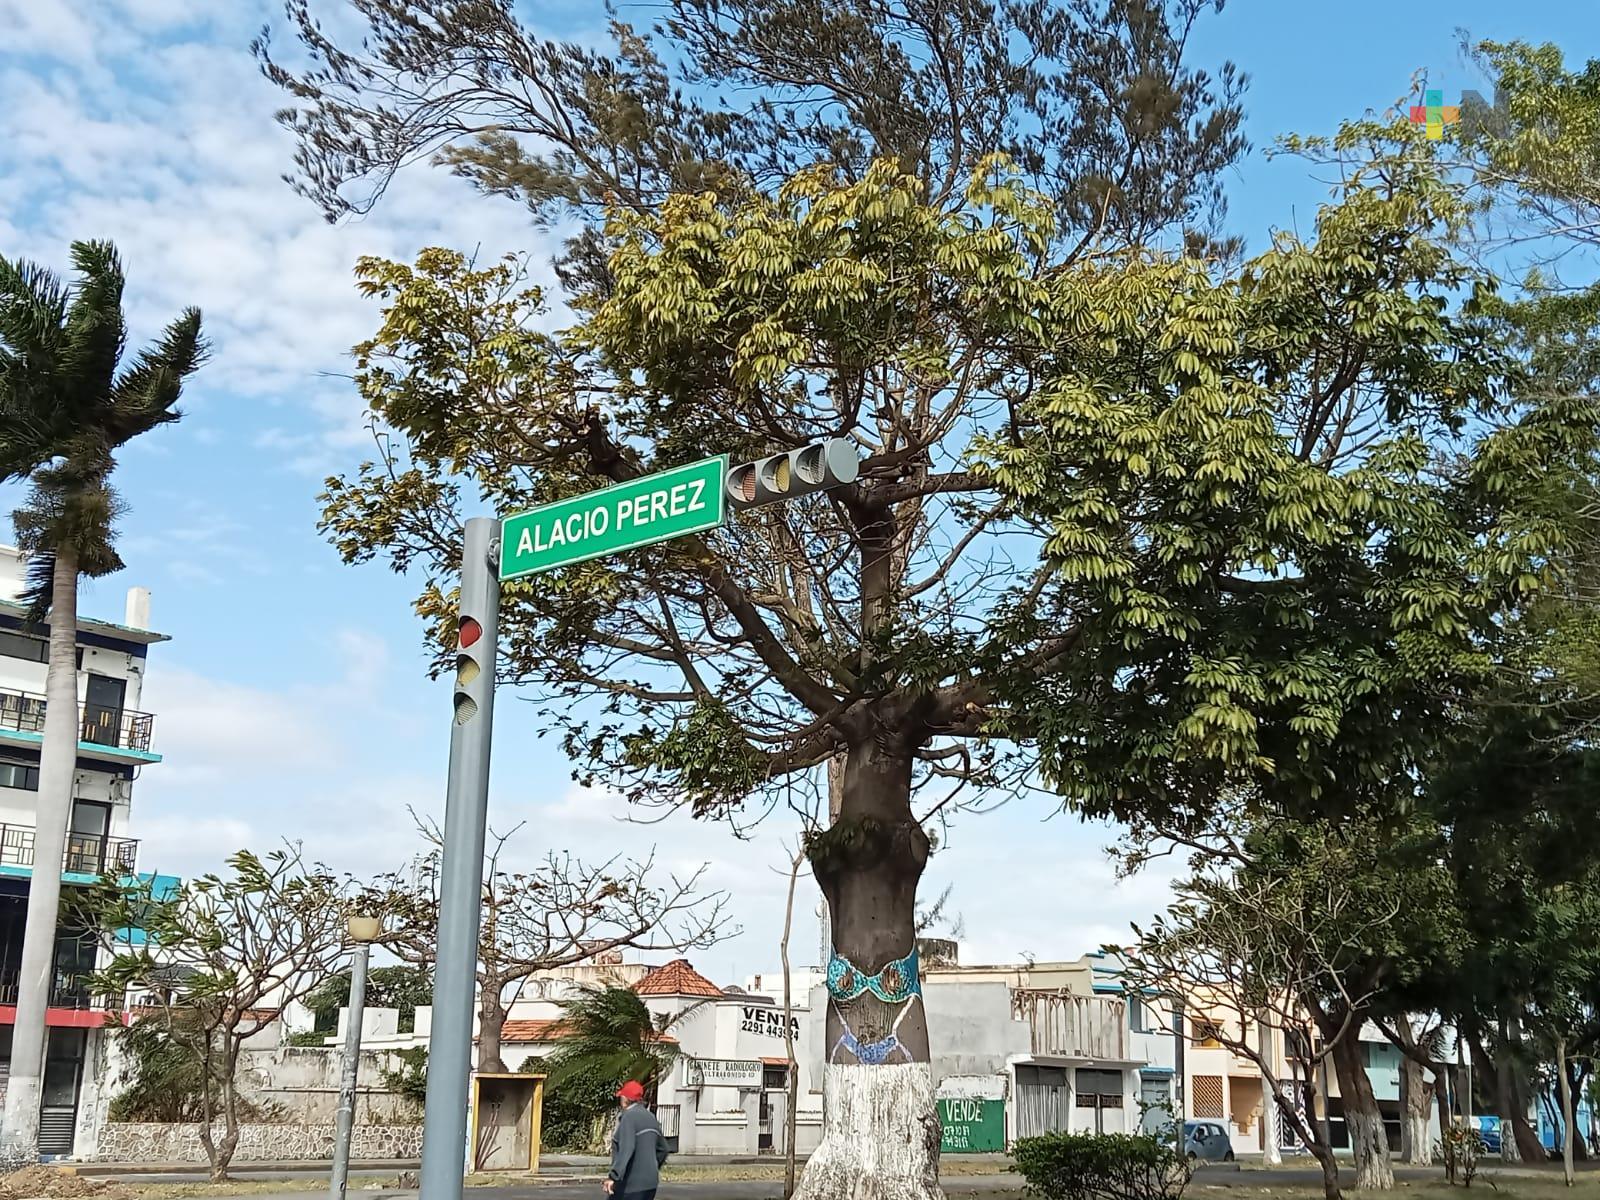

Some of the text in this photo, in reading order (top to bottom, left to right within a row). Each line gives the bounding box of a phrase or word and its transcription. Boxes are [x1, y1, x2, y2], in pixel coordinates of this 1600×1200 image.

[515, 478, 706, 558] ALACIO PEREZ
[741, 1020, 764, 1035] 2291
[743, 1007, 800, 1030] VENTA
[945, 1099, 984, 1123] VENDE
